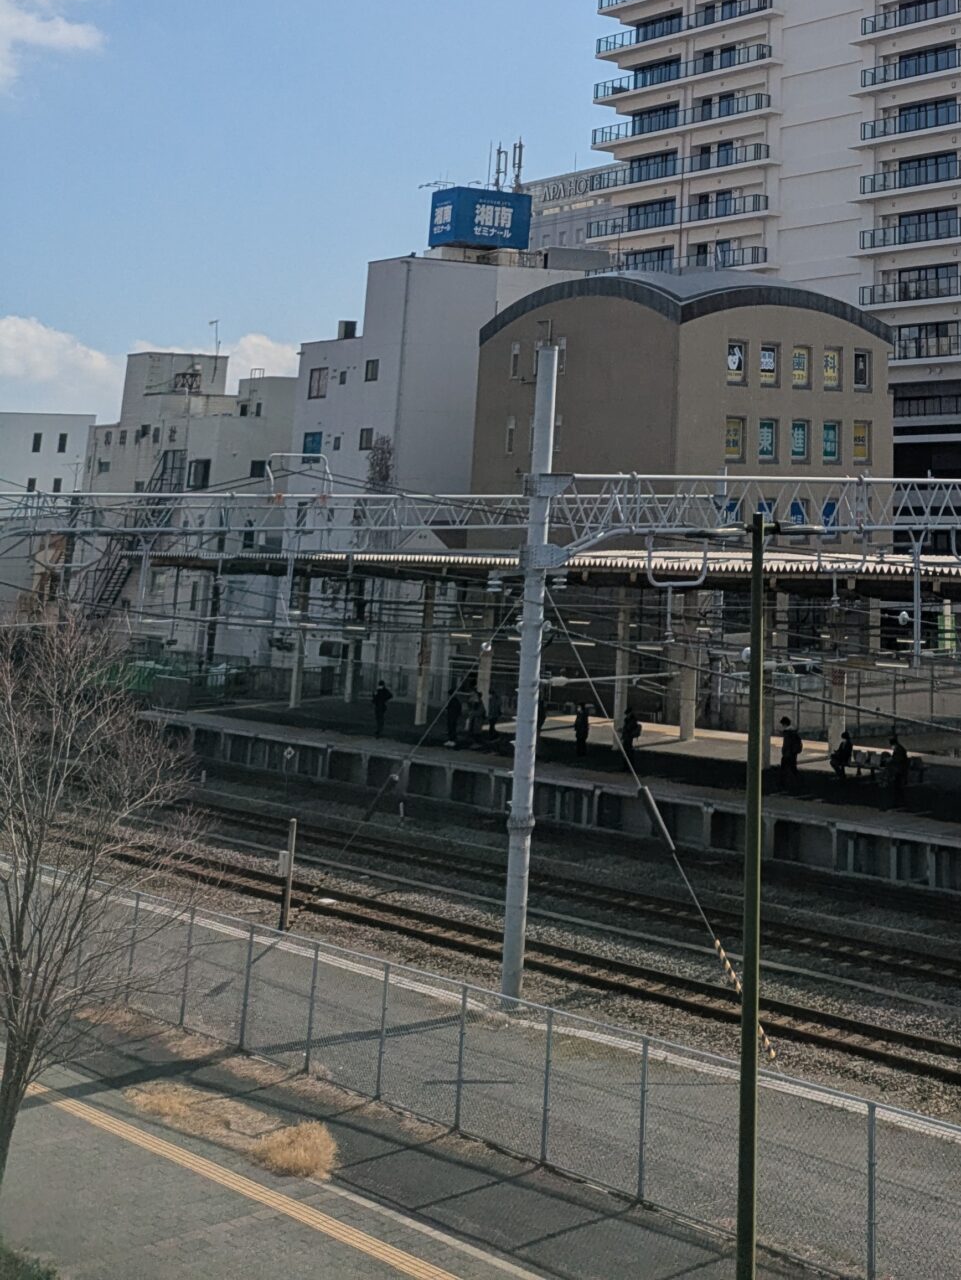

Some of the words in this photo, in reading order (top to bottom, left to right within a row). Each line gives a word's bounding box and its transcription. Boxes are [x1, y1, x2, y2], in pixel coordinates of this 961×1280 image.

[474, 204, 514, 228] 湘南
[473, 225, 512, 239] ゼミナール
